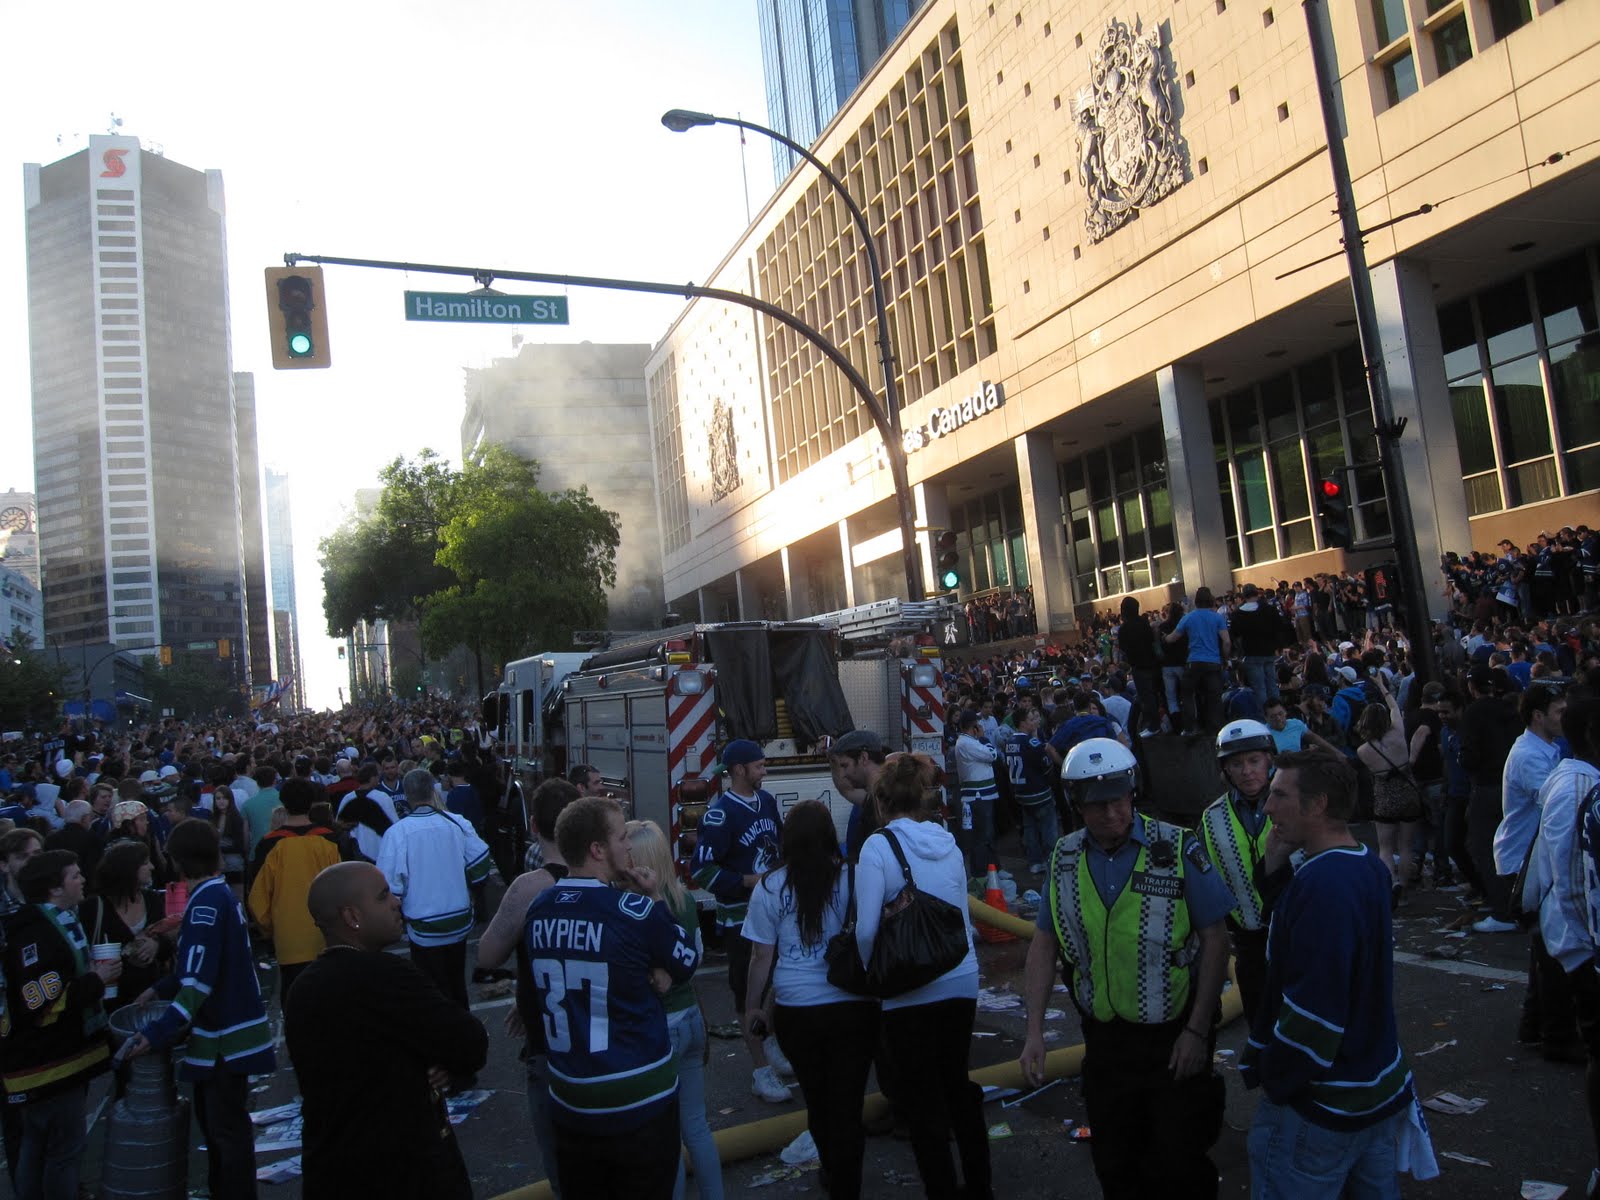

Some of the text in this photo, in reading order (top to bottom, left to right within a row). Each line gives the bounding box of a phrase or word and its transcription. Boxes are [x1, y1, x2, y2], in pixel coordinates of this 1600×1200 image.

[415, 296, 558, 319] Hamilton St
[927, 379, 1000, 438] Canada
[1006, 755, 1026, 785] 22
[739, 818, 778, 847] VANCOUV
[699, 845, 714, 861] 14
[1134, 883, 1184, 897] AUTHORITY
[1143, 875, 1181, 888] TRAFFIC
[532, 918, 603, 953] RYPIEN
[186, 944, 205, 974] 17
[22, 970, 63, 1010] 96
[531, 958, 609, 1054] 37
